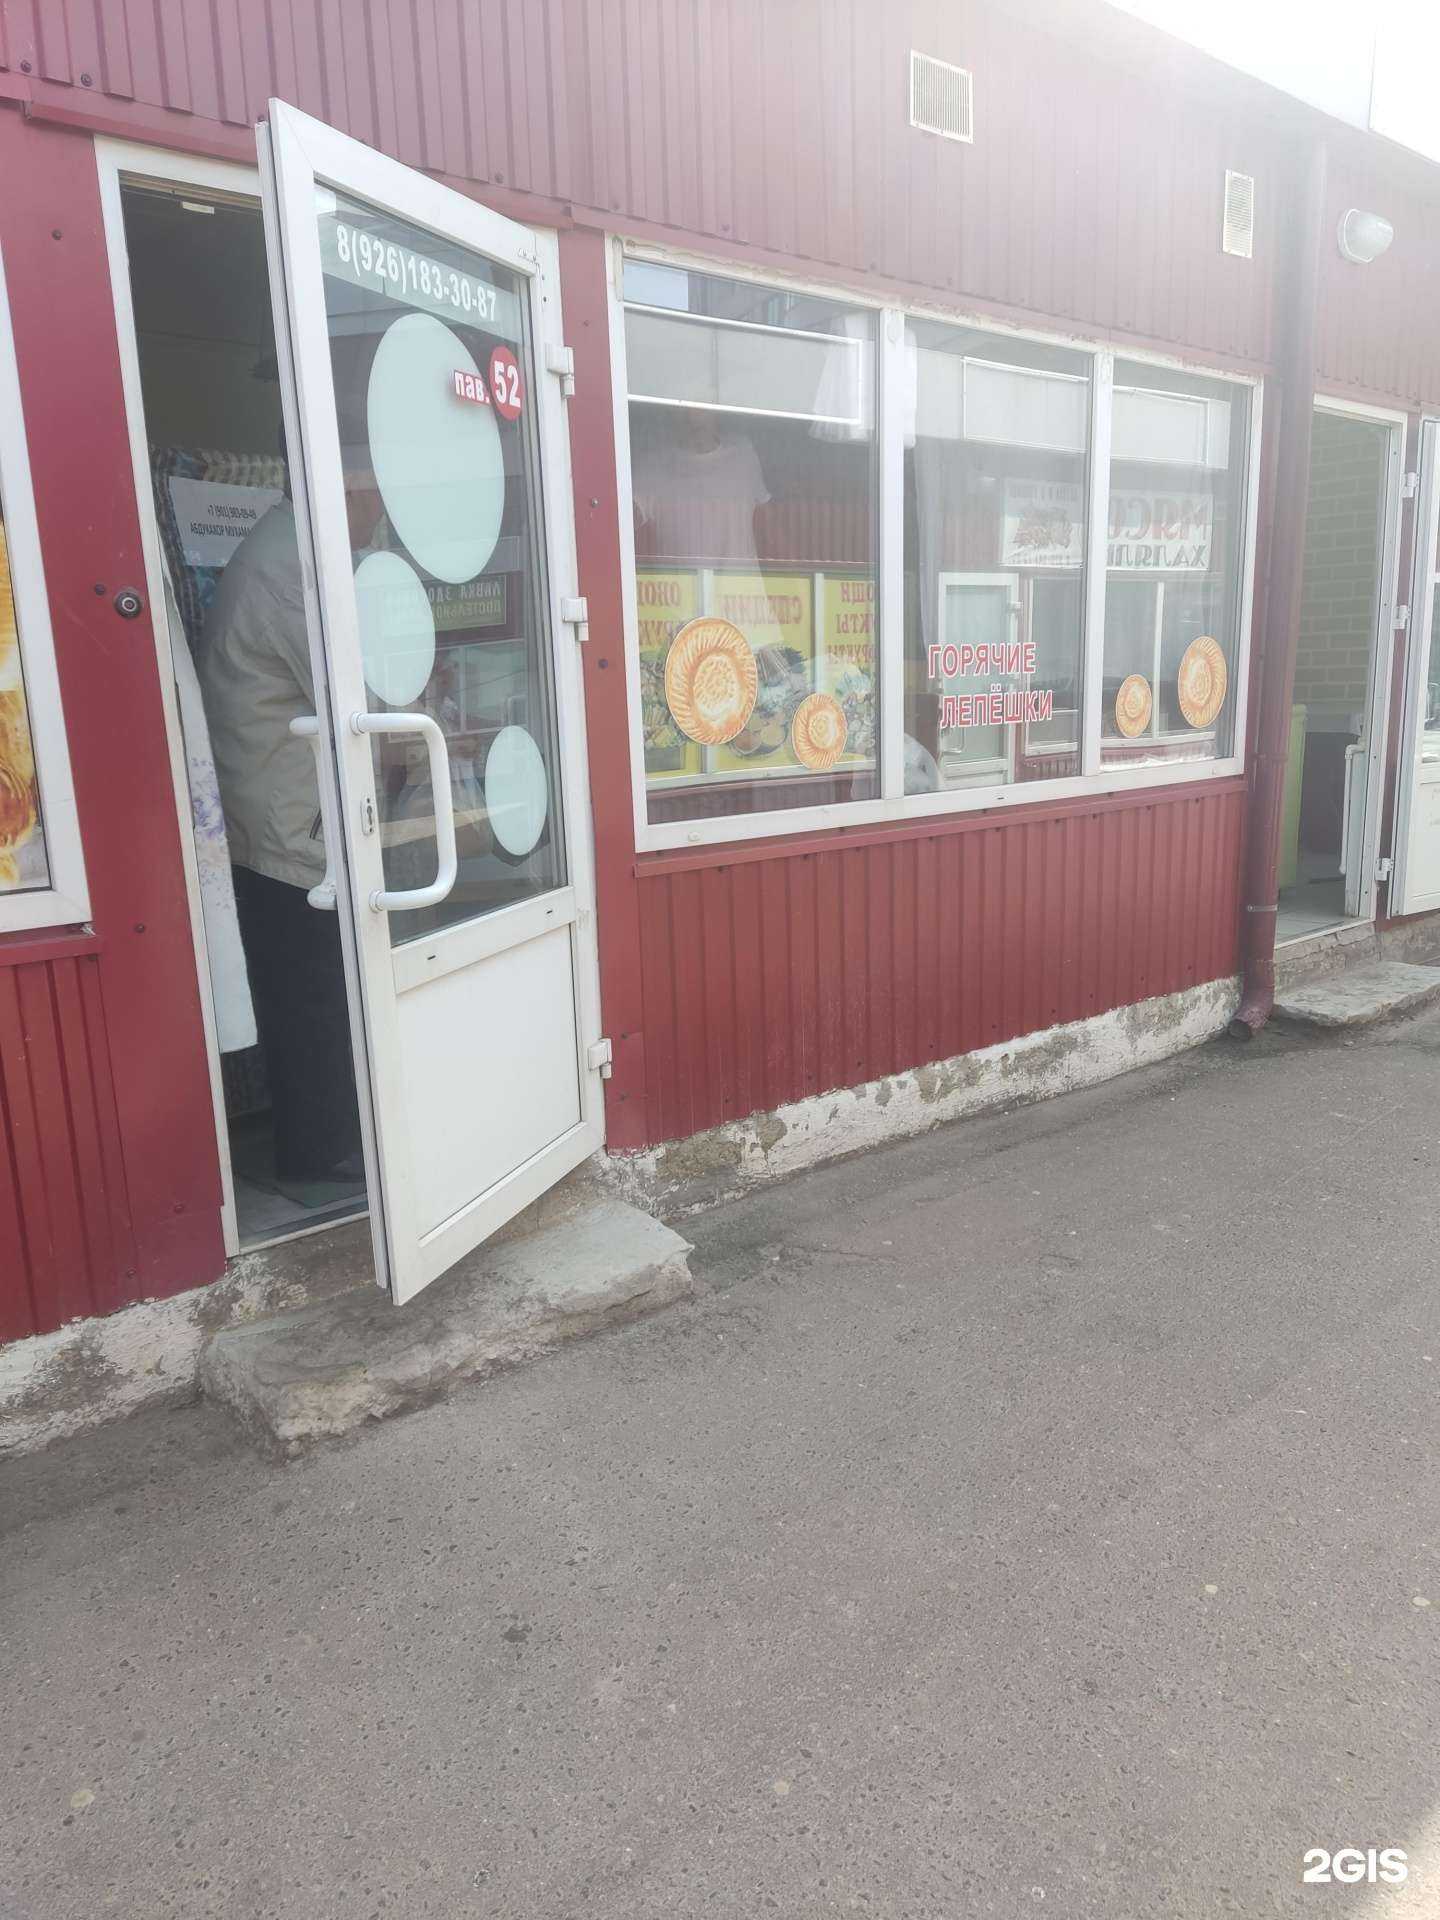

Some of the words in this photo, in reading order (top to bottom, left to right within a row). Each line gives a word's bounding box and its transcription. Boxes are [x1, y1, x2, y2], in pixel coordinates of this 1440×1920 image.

[336, 223, 497, 322] 8(926)183-30-87
[453, 371, 490, 405] пав.
[493, 360, 521, 408] 52
[927, 641, 1038, 680] ГОРЯЧИЕ
[939, 682, 1055, 729] ЛЕПЁШКИ
